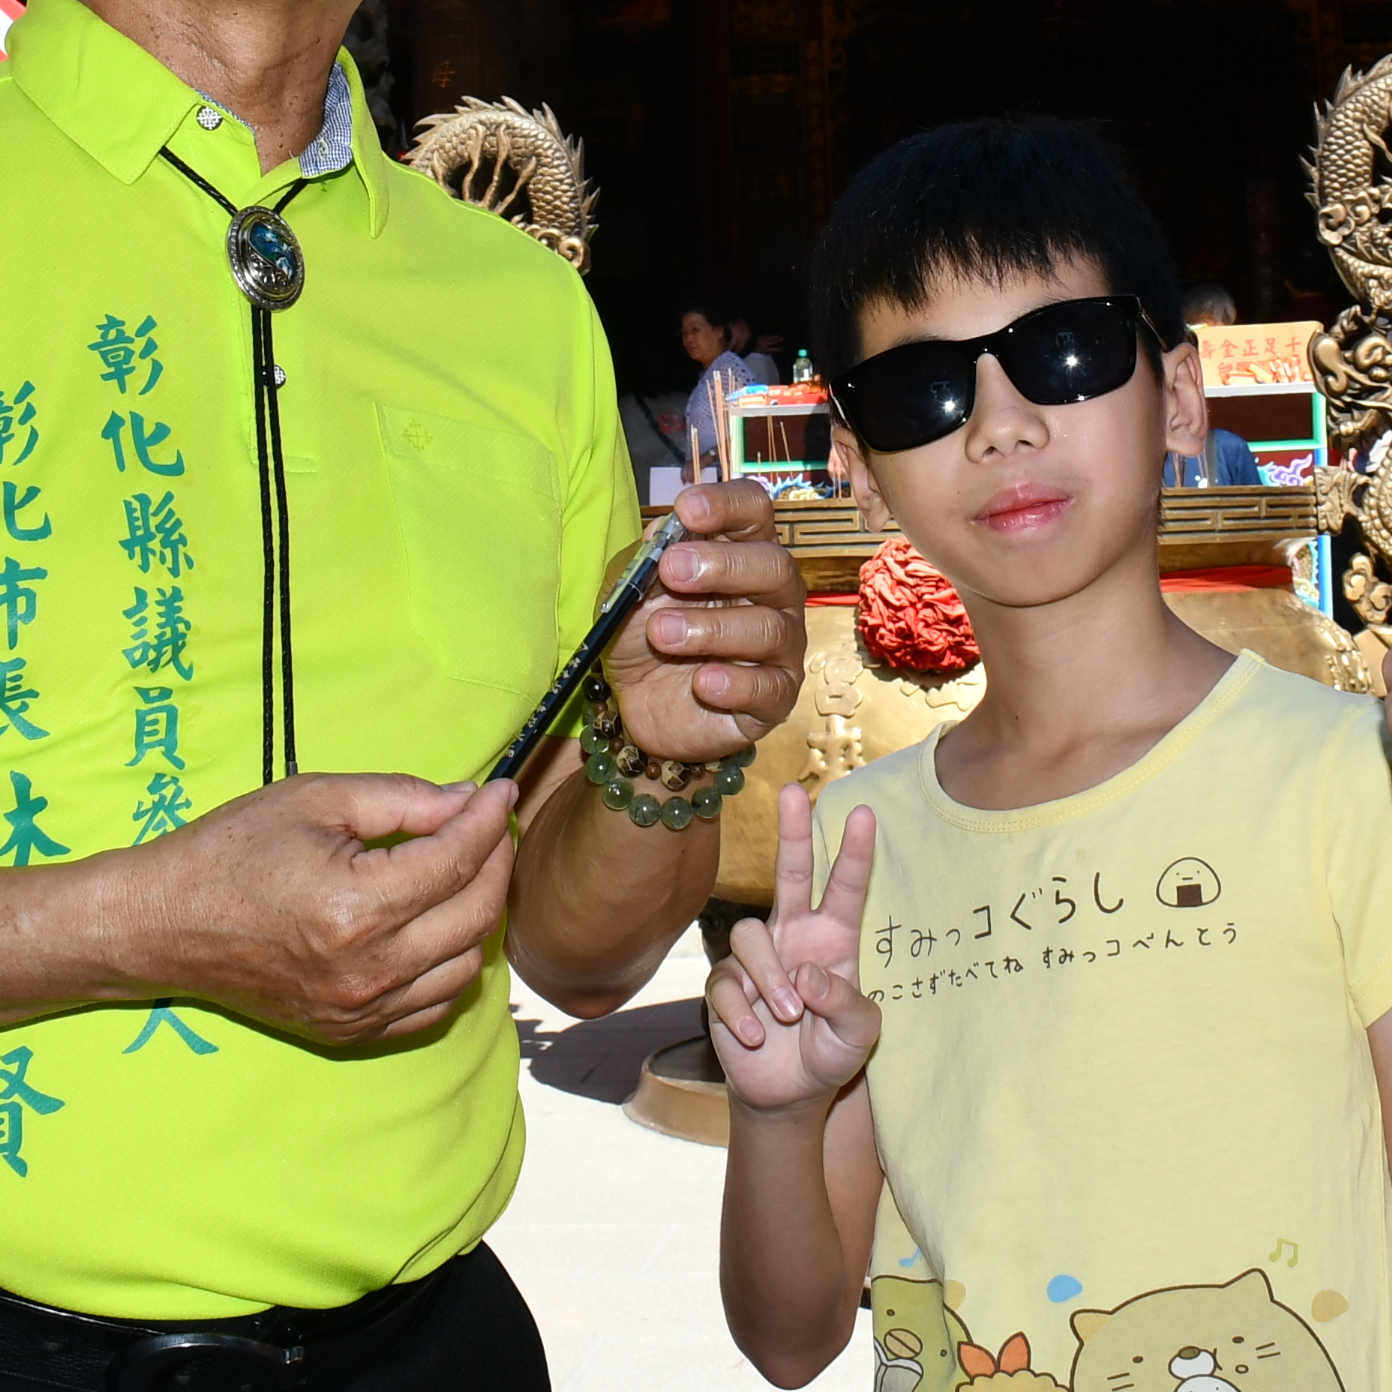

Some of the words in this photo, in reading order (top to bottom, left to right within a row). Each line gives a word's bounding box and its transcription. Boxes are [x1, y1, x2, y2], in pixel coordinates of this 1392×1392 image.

[86, 312, 219, 1057] 彰化縣議員參人
[874, 871, 1125, 969] すみっコぐらし
